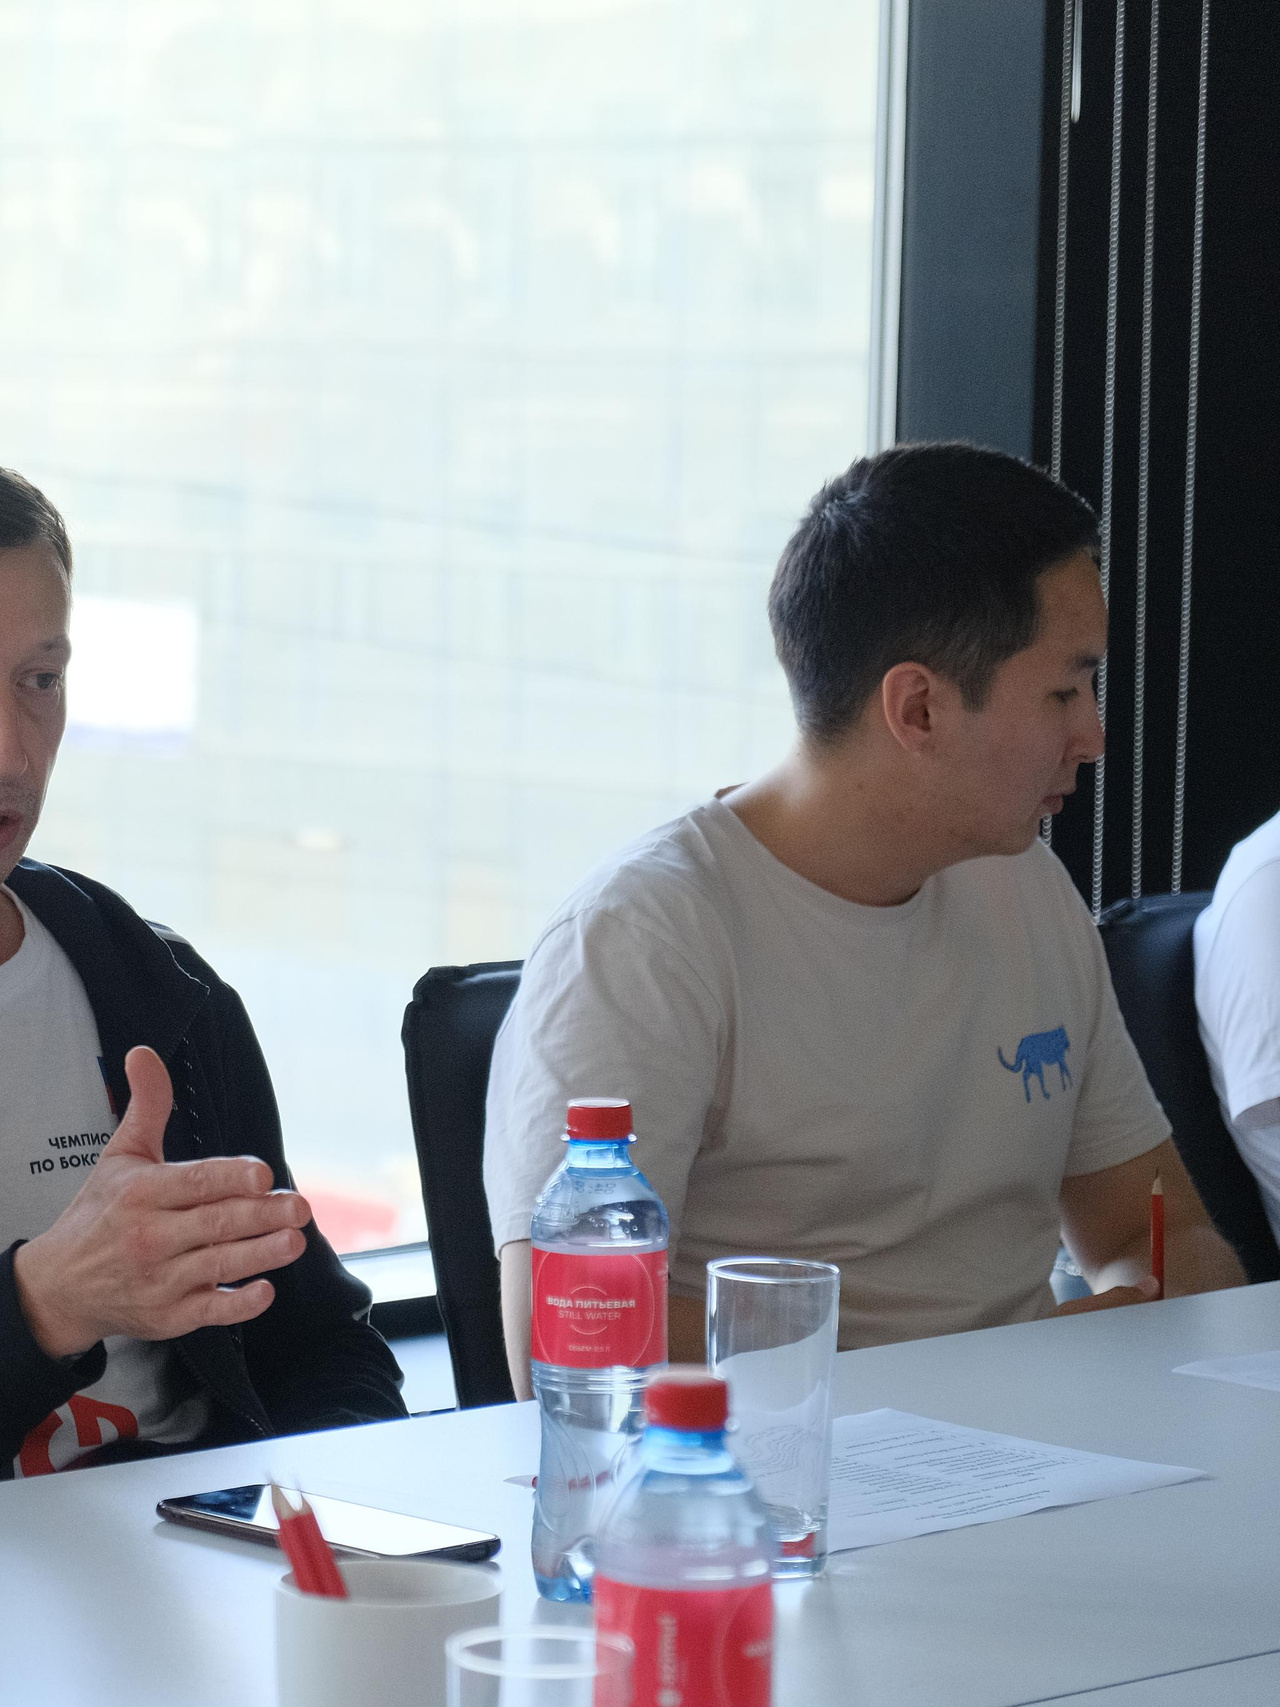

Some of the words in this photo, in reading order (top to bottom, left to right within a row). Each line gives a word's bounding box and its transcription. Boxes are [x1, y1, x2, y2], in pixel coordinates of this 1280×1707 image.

[48, 1132, 114, 1150] ЧЕМПИО
[29, 1158, 55, 1175] ПО
[60, 1152, 100, 1170] БОКС
[546, 1297, 573, 1309] ВОДА
[575, 1300, 636, 1310] ПИТЬЕВАЯ
[558, 1310, 583, 1320] STILL
[585, 1311, 622, 1321] WATER
